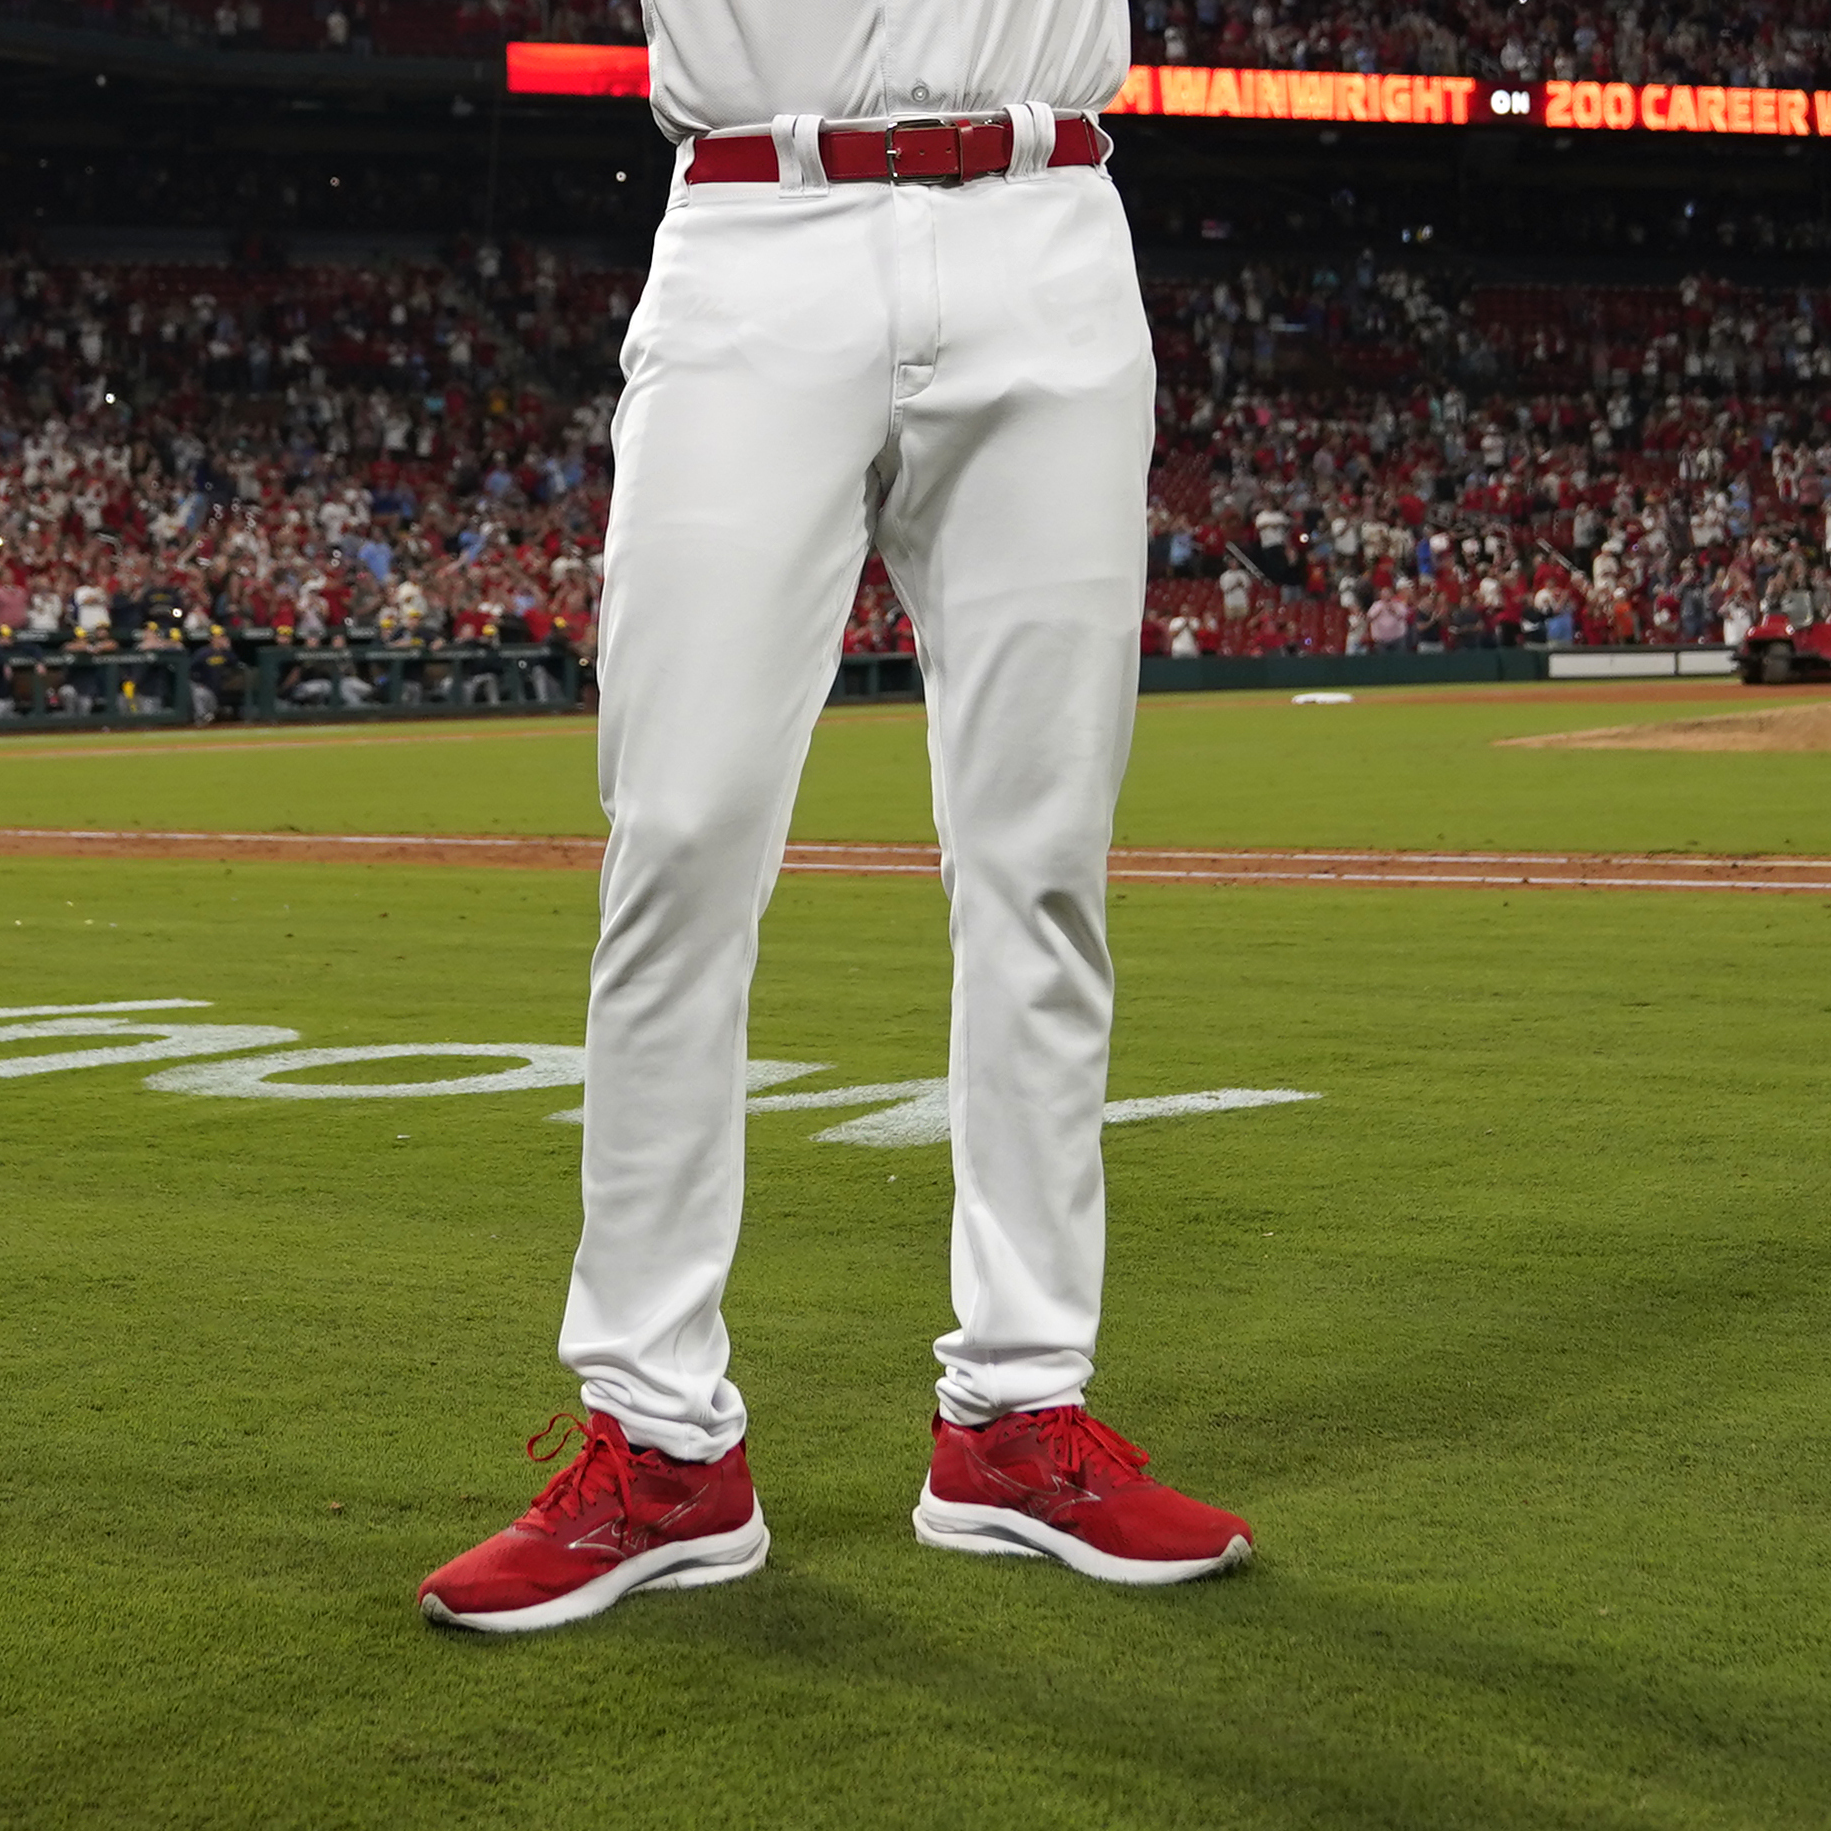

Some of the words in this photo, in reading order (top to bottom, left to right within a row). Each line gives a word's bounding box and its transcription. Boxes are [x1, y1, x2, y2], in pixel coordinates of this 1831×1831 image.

[1158, 65, 1475, 125] WAINWRIGHT
[1490, 89, 1531, 115] ON
[1545, 80, 1634, 130] 200
[1641, 84, 1809, 136] CAREER
